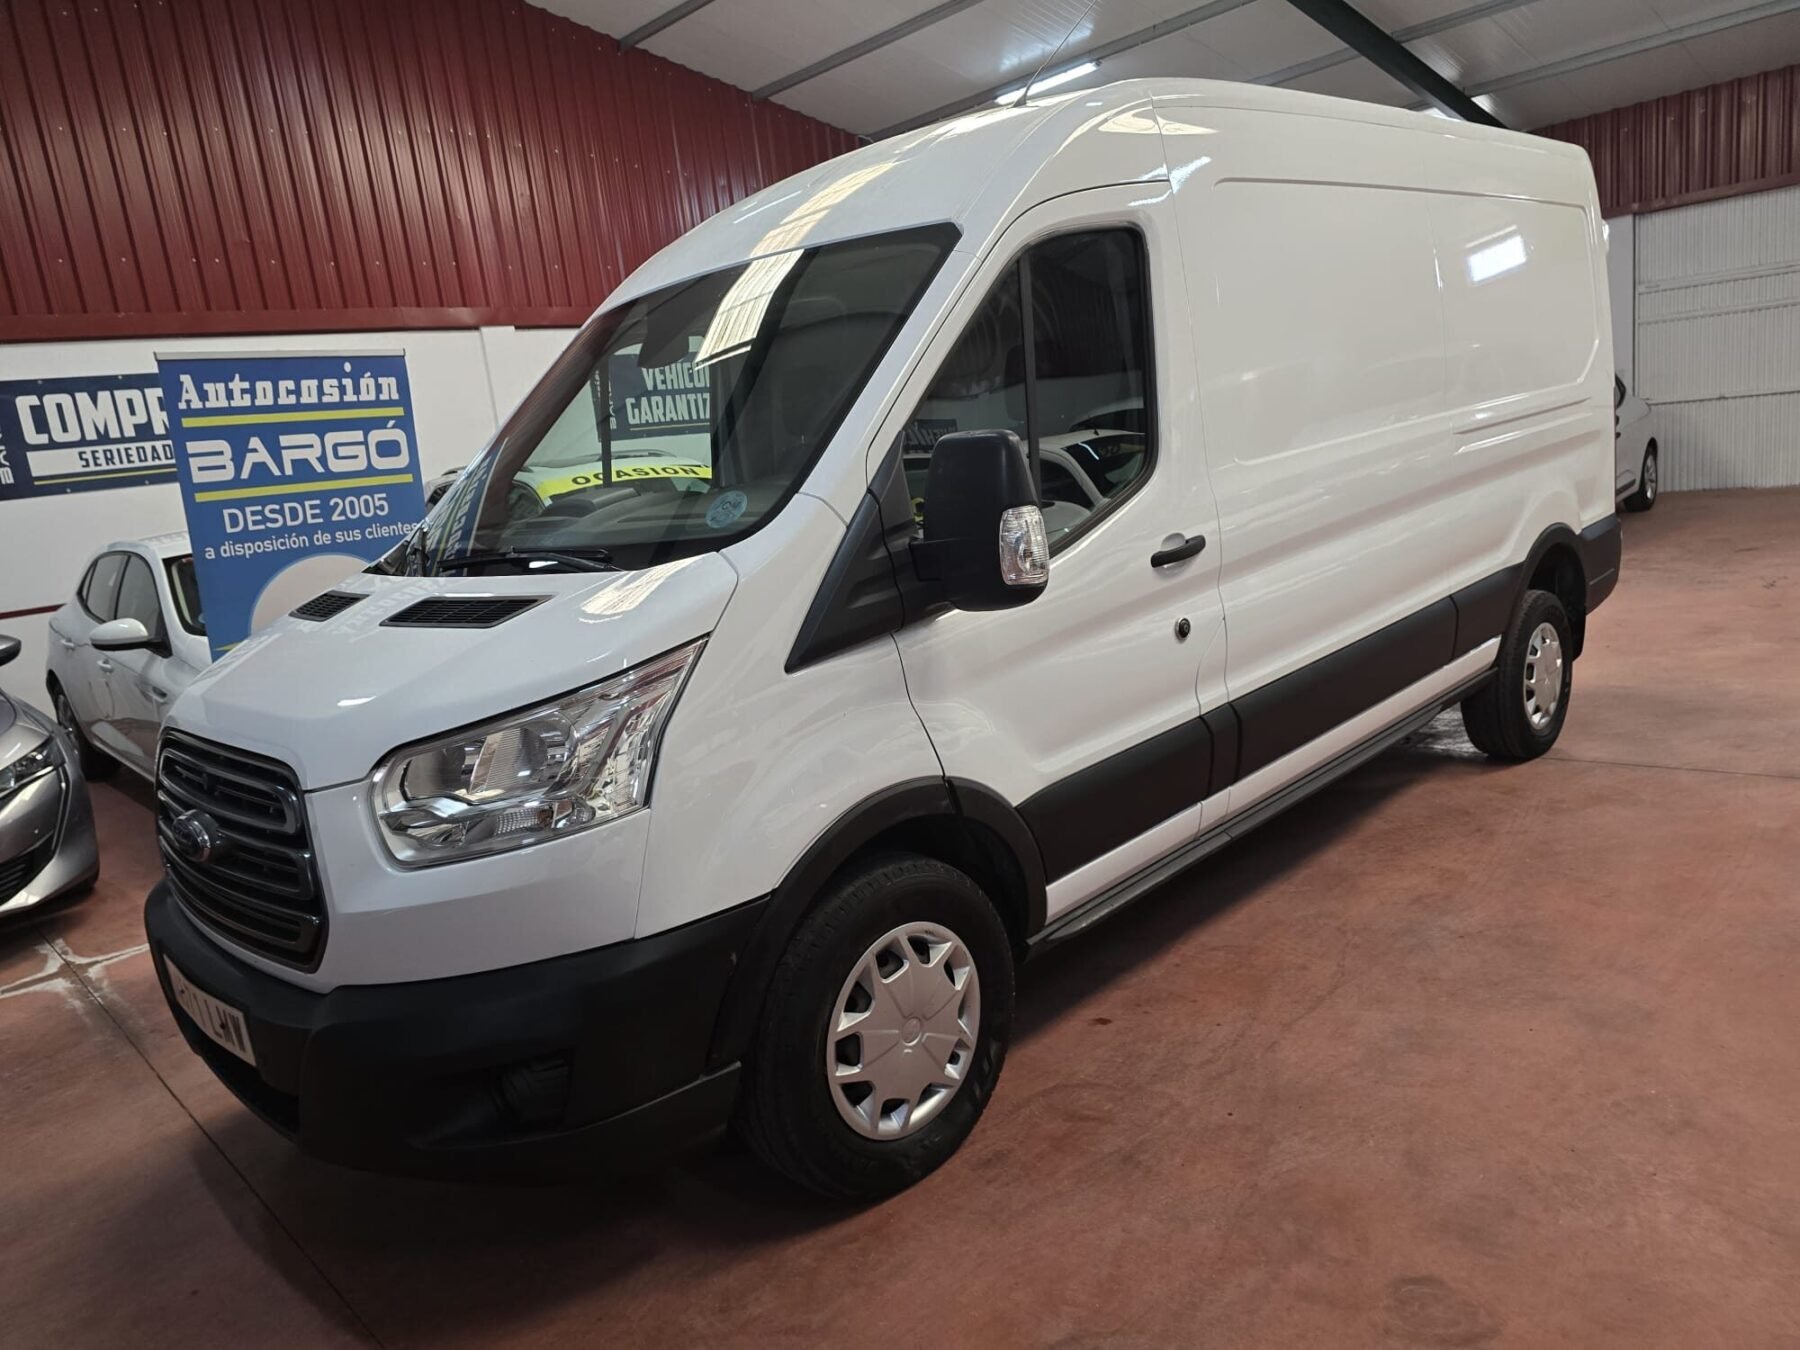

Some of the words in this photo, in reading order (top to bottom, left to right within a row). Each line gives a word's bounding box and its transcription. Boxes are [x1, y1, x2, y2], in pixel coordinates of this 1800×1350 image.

[178, 361, 400, 410] Autocasión
[78, 444, 174, 469] SERIEDAD
[185, 420, 410, 483] BARGÓ
[222, 500, 324, 534] DESDE
[329, 493, 389, 522] 2005
[205, 547, 215, 560] a
[220, 532, 309, 559] disposición
[313, 529, 331, 546] de
[335, 528, 361, 542] sus
